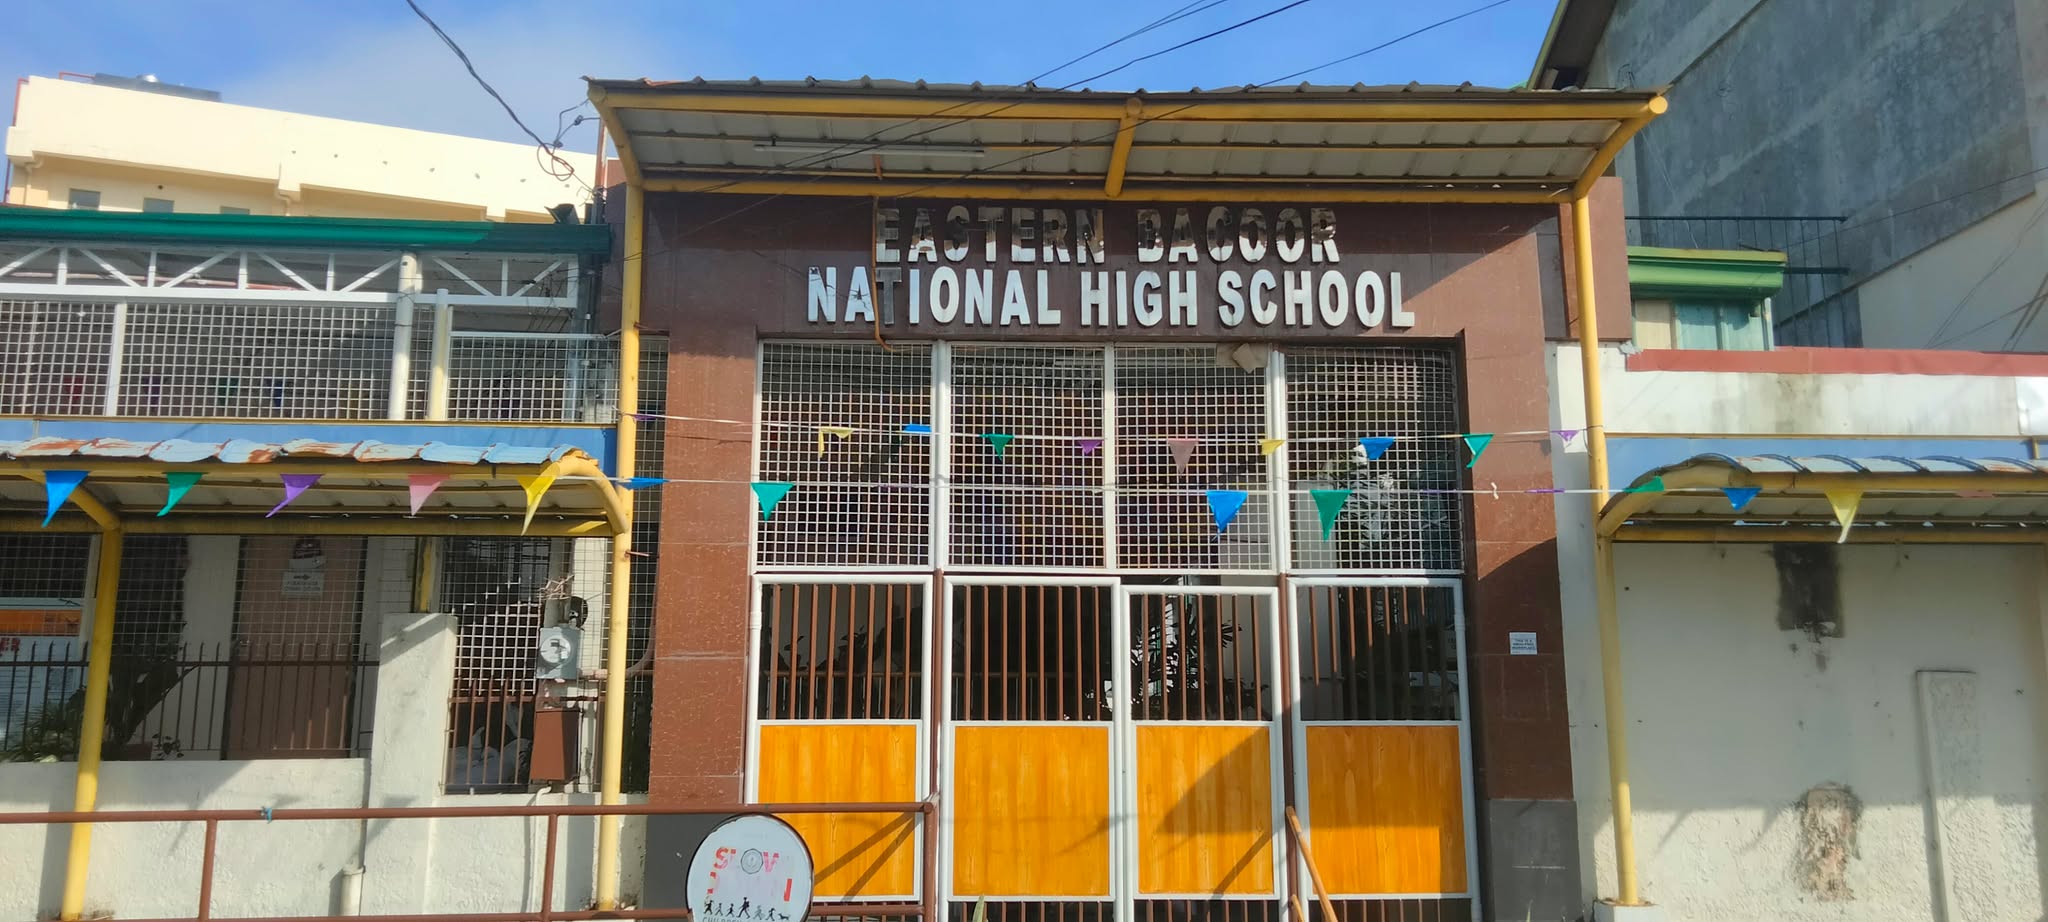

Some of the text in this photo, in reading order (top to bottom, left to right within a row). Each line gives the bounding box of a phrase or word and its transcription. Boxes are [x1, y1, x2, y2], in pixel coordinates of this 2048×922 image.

[876, 205, 1340, 263] EASTERN BACOOR
[807, 266, 1416, 328] NATIONAL HIGH SCHOOL
